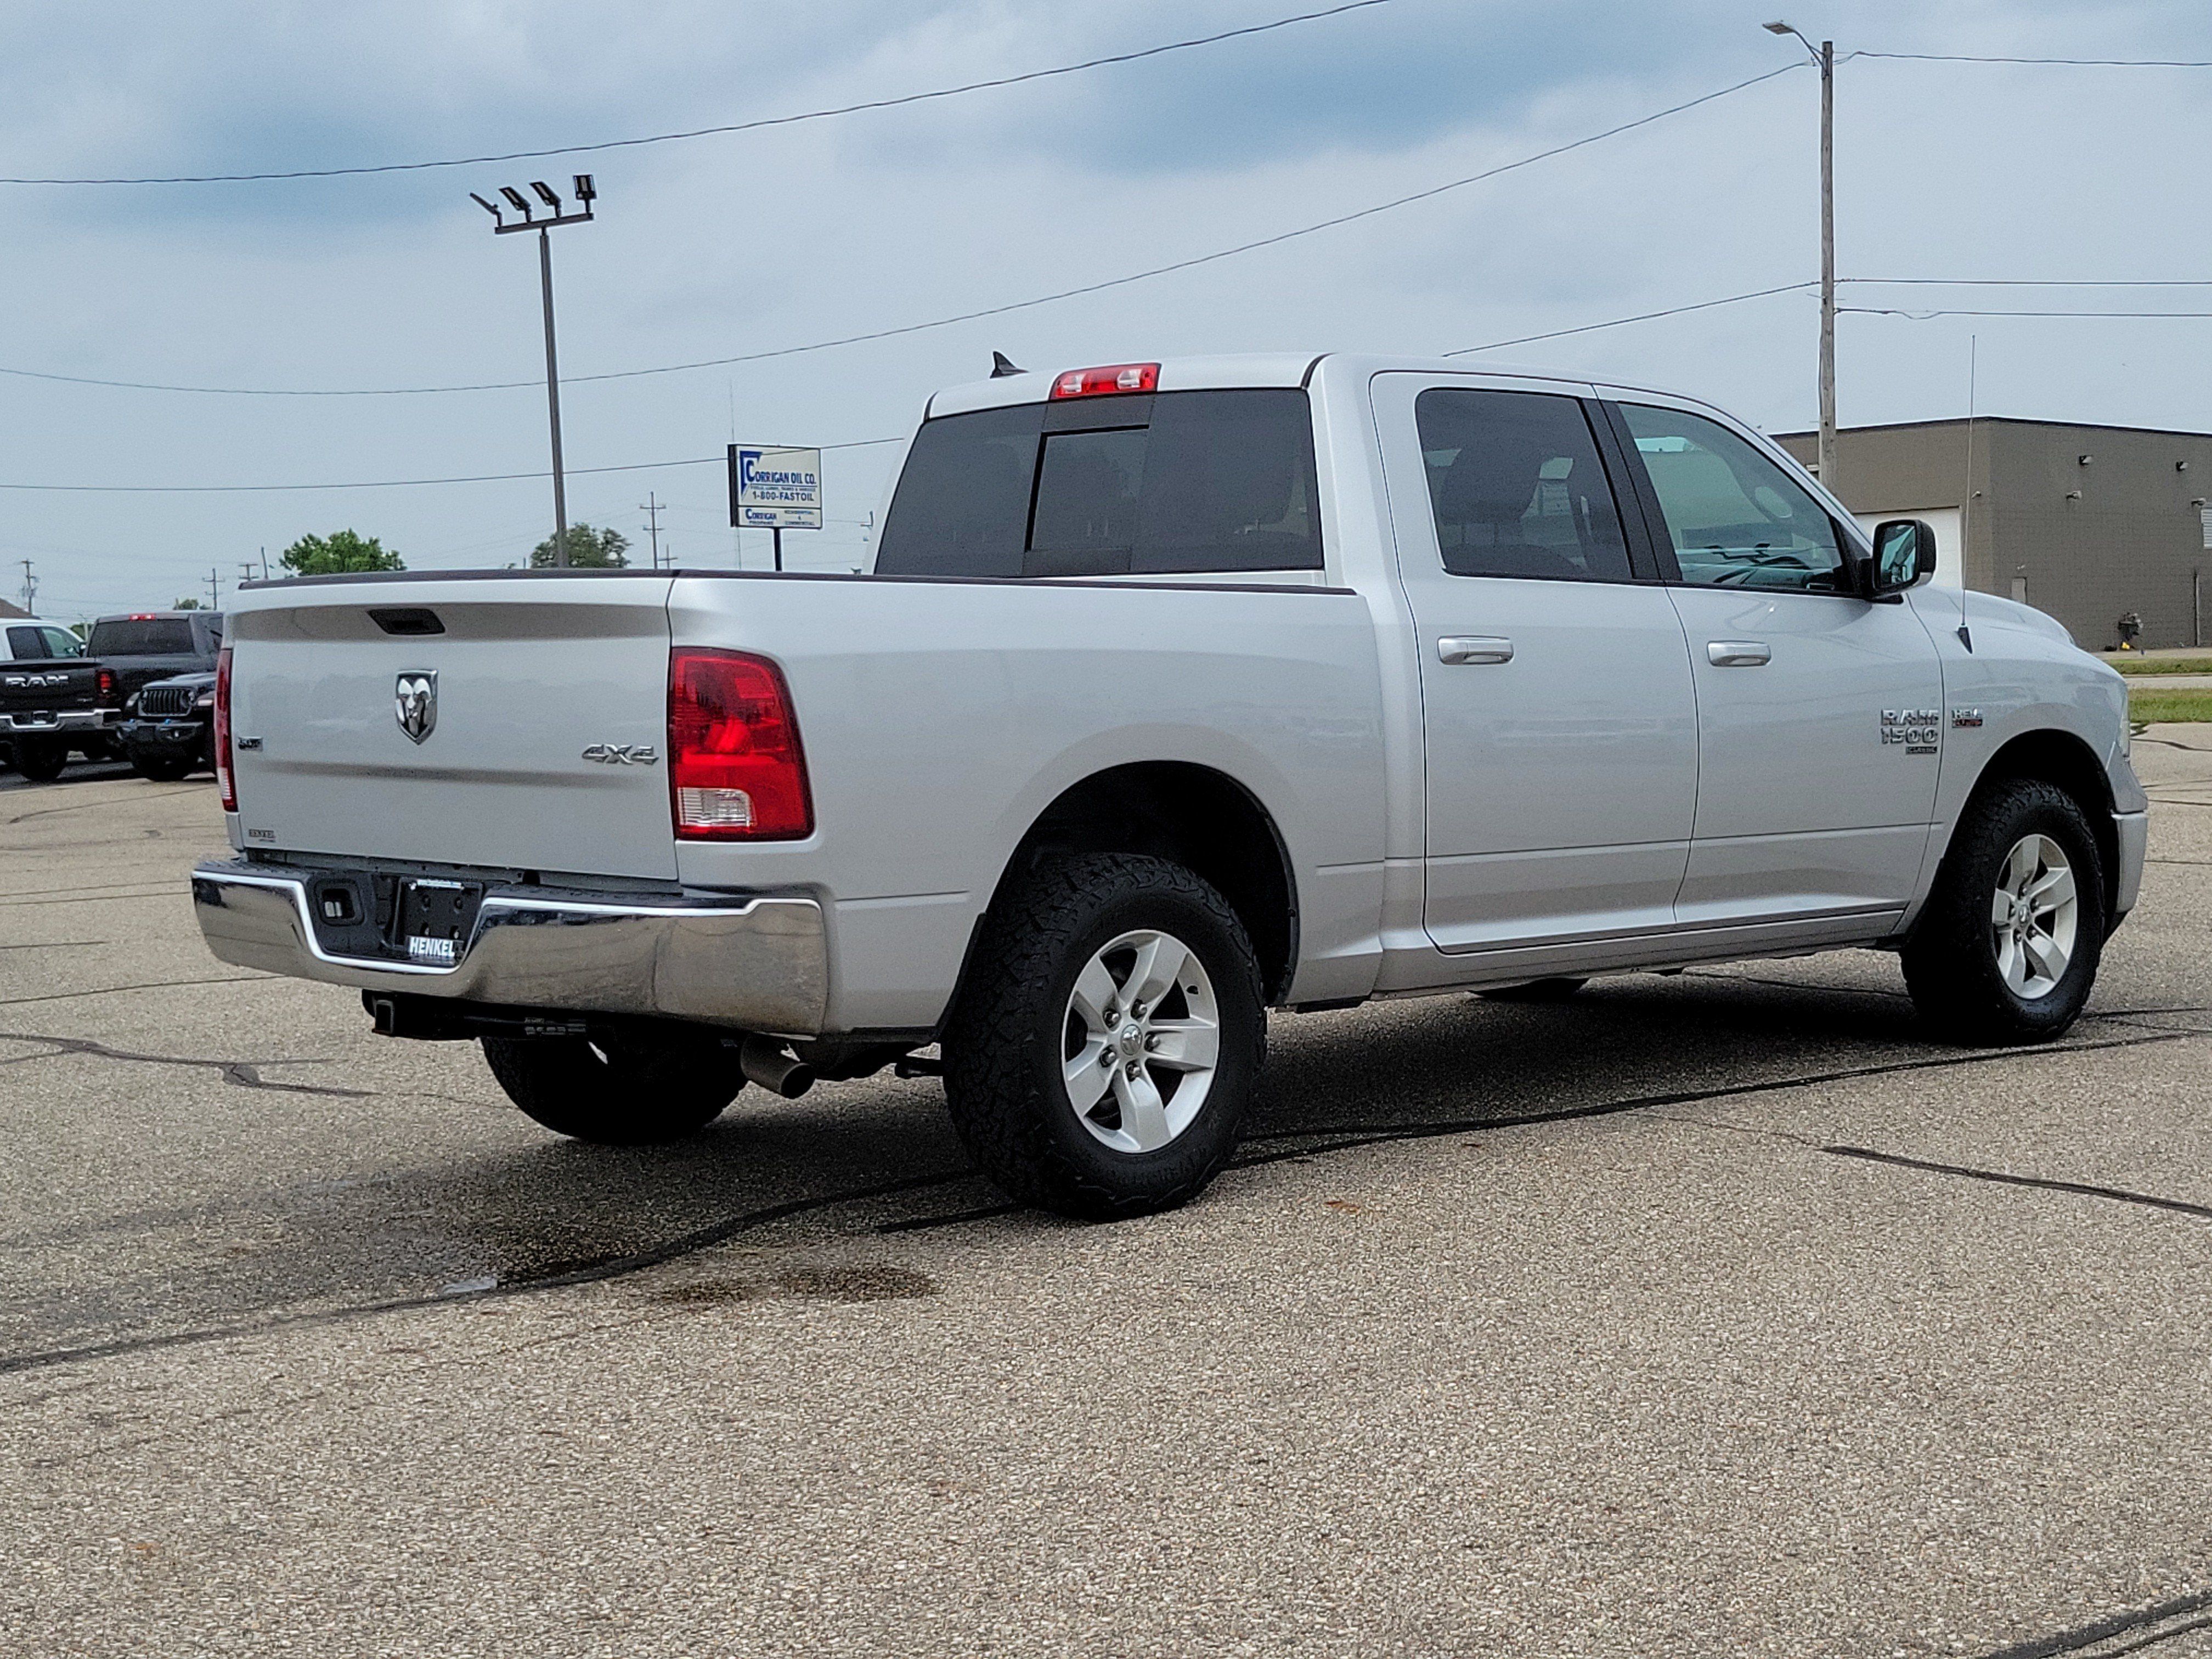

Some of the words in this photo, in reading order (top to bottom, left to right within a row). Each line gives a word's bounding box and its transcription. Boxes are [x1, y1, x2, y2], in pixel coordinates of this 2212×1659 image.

[746, 460, 789, 483] CORRIGAN
[791, 472, 803, 484] OIL
[804, 473, 816, 484] CO.
[752, 490, 815, 501] 1-800-FASTOIL
[745, 508, 777, 520] CORRIGAN
[5, 675, 69, 687] RAM
[1881, 709, 1939, 725] RAM
[1881, 727, 1938, 744] 1500
[409, 936, 455, 957] HENKEL
